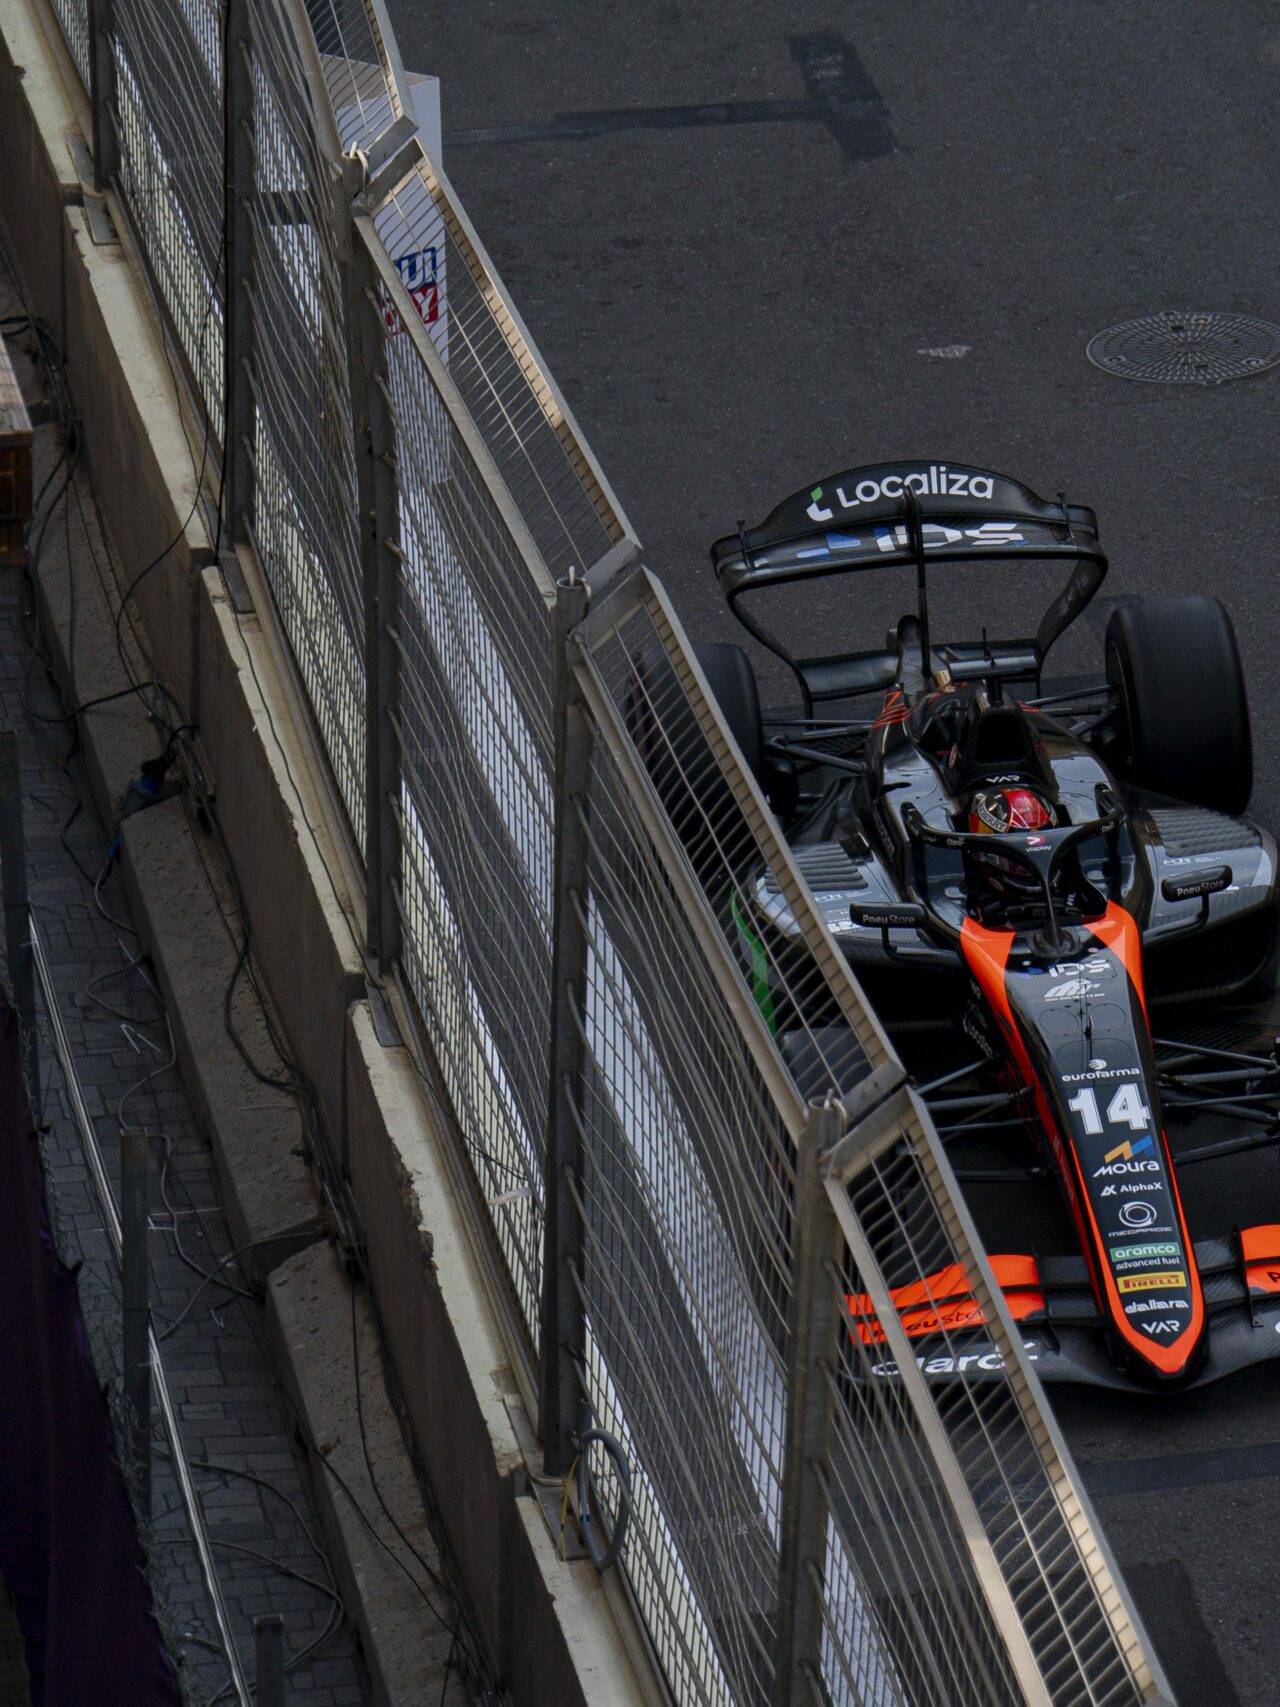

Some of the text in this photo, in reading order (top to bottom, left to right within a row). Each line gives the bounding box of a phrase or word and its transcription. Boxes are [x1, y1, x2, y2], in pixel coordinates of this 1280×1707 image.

[836, 465, 994, 508] Localiza
[1176, 879, 1225, 898] PneuStore
[862, 913, 916, 926] PneuStore
[1061, 1067, 1140, 1082] eurofarma
[1068, 1083, 1150, 1135] 14
[1120, 1181, 1163, 1193] AlphaX
[1115, 1244, 1175, 1259] aramco
[1116, 1256, 1180, 1270] advanced fuel
[1123, 1275, 1180, 1289] PIRELLI
[1125, 1299, 1189, 1314] dallara
[1142, 1319, 1180, 1334] VAR
